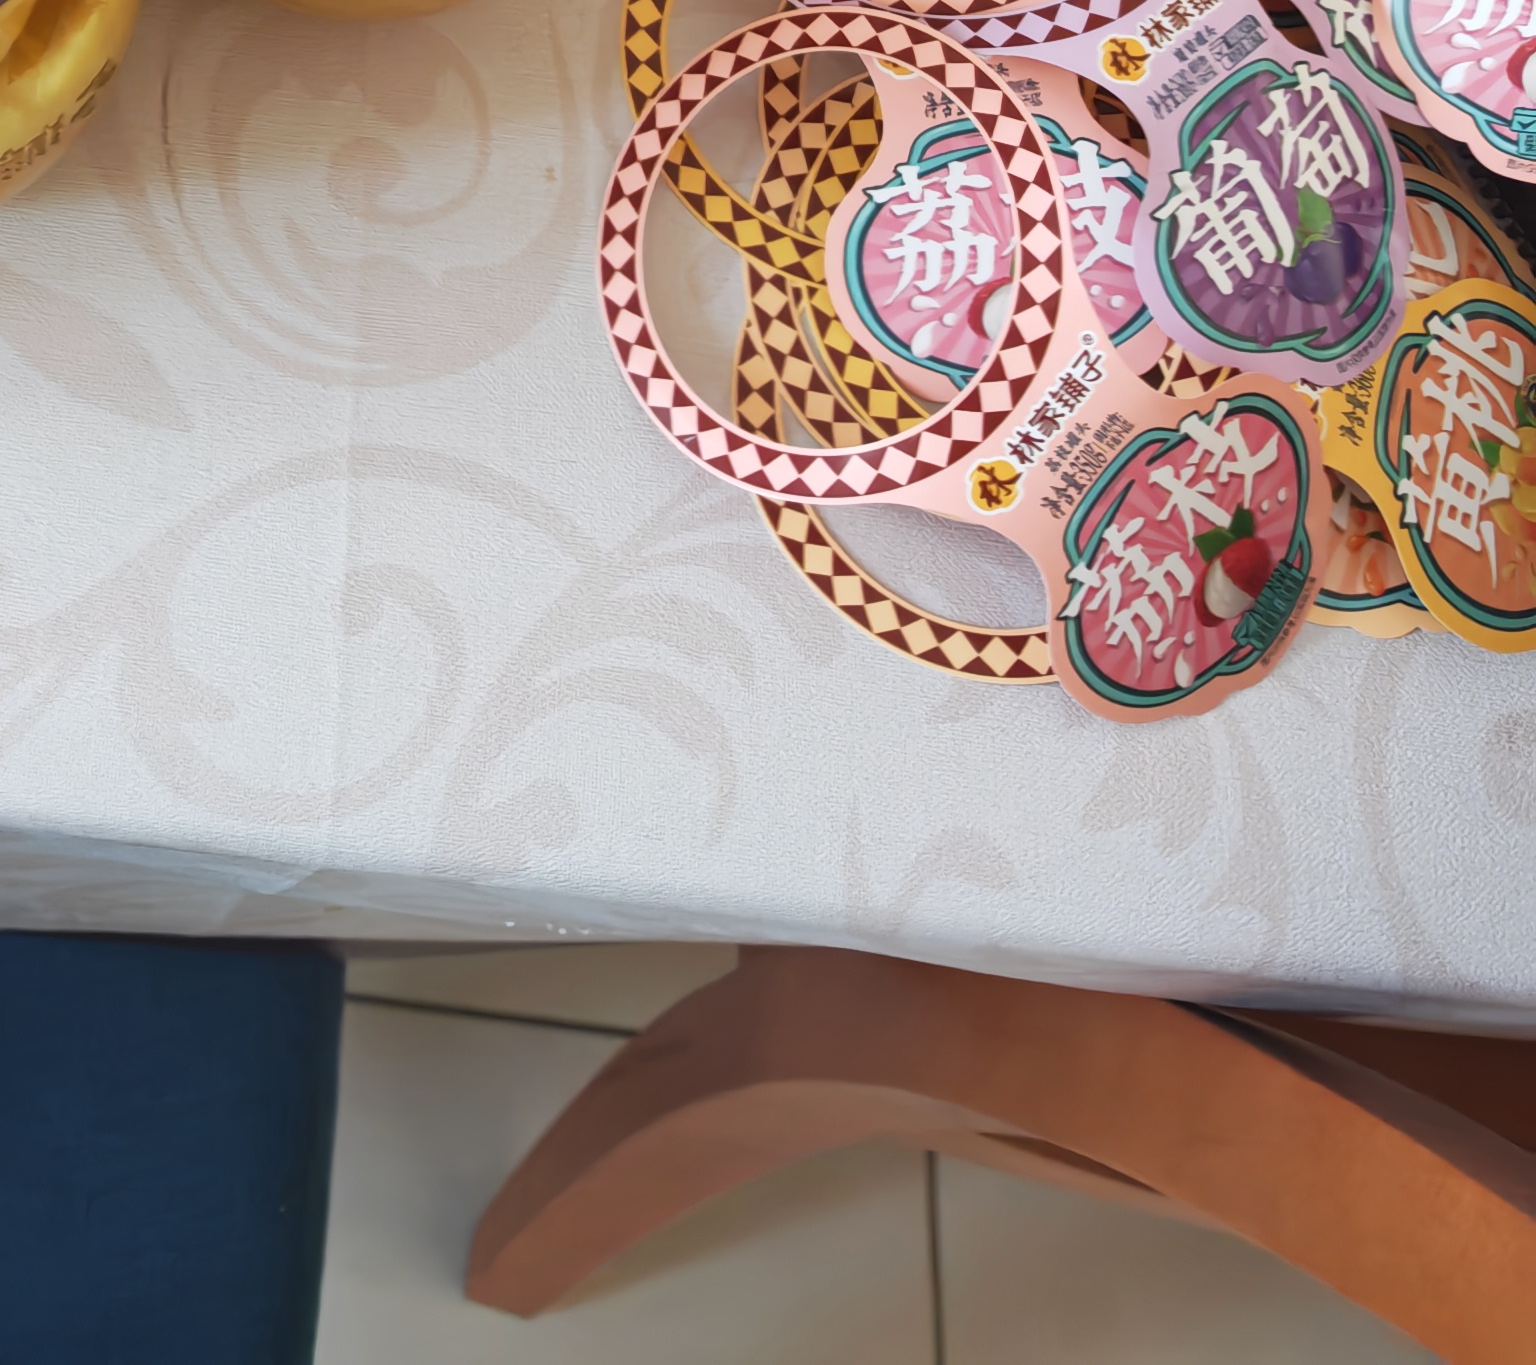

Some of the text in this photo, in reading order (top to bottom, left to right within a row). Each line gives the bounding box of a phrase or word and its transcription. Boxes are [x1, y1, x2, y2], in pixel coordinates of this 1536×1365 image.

[1153, 64, 1372, 295] 葡萄
[1007, 349, 1105, 466] 林家铺子
[1398, 312, 1525, 589] 黄桃
[1060, 401, 1280, 679] 荔枝
